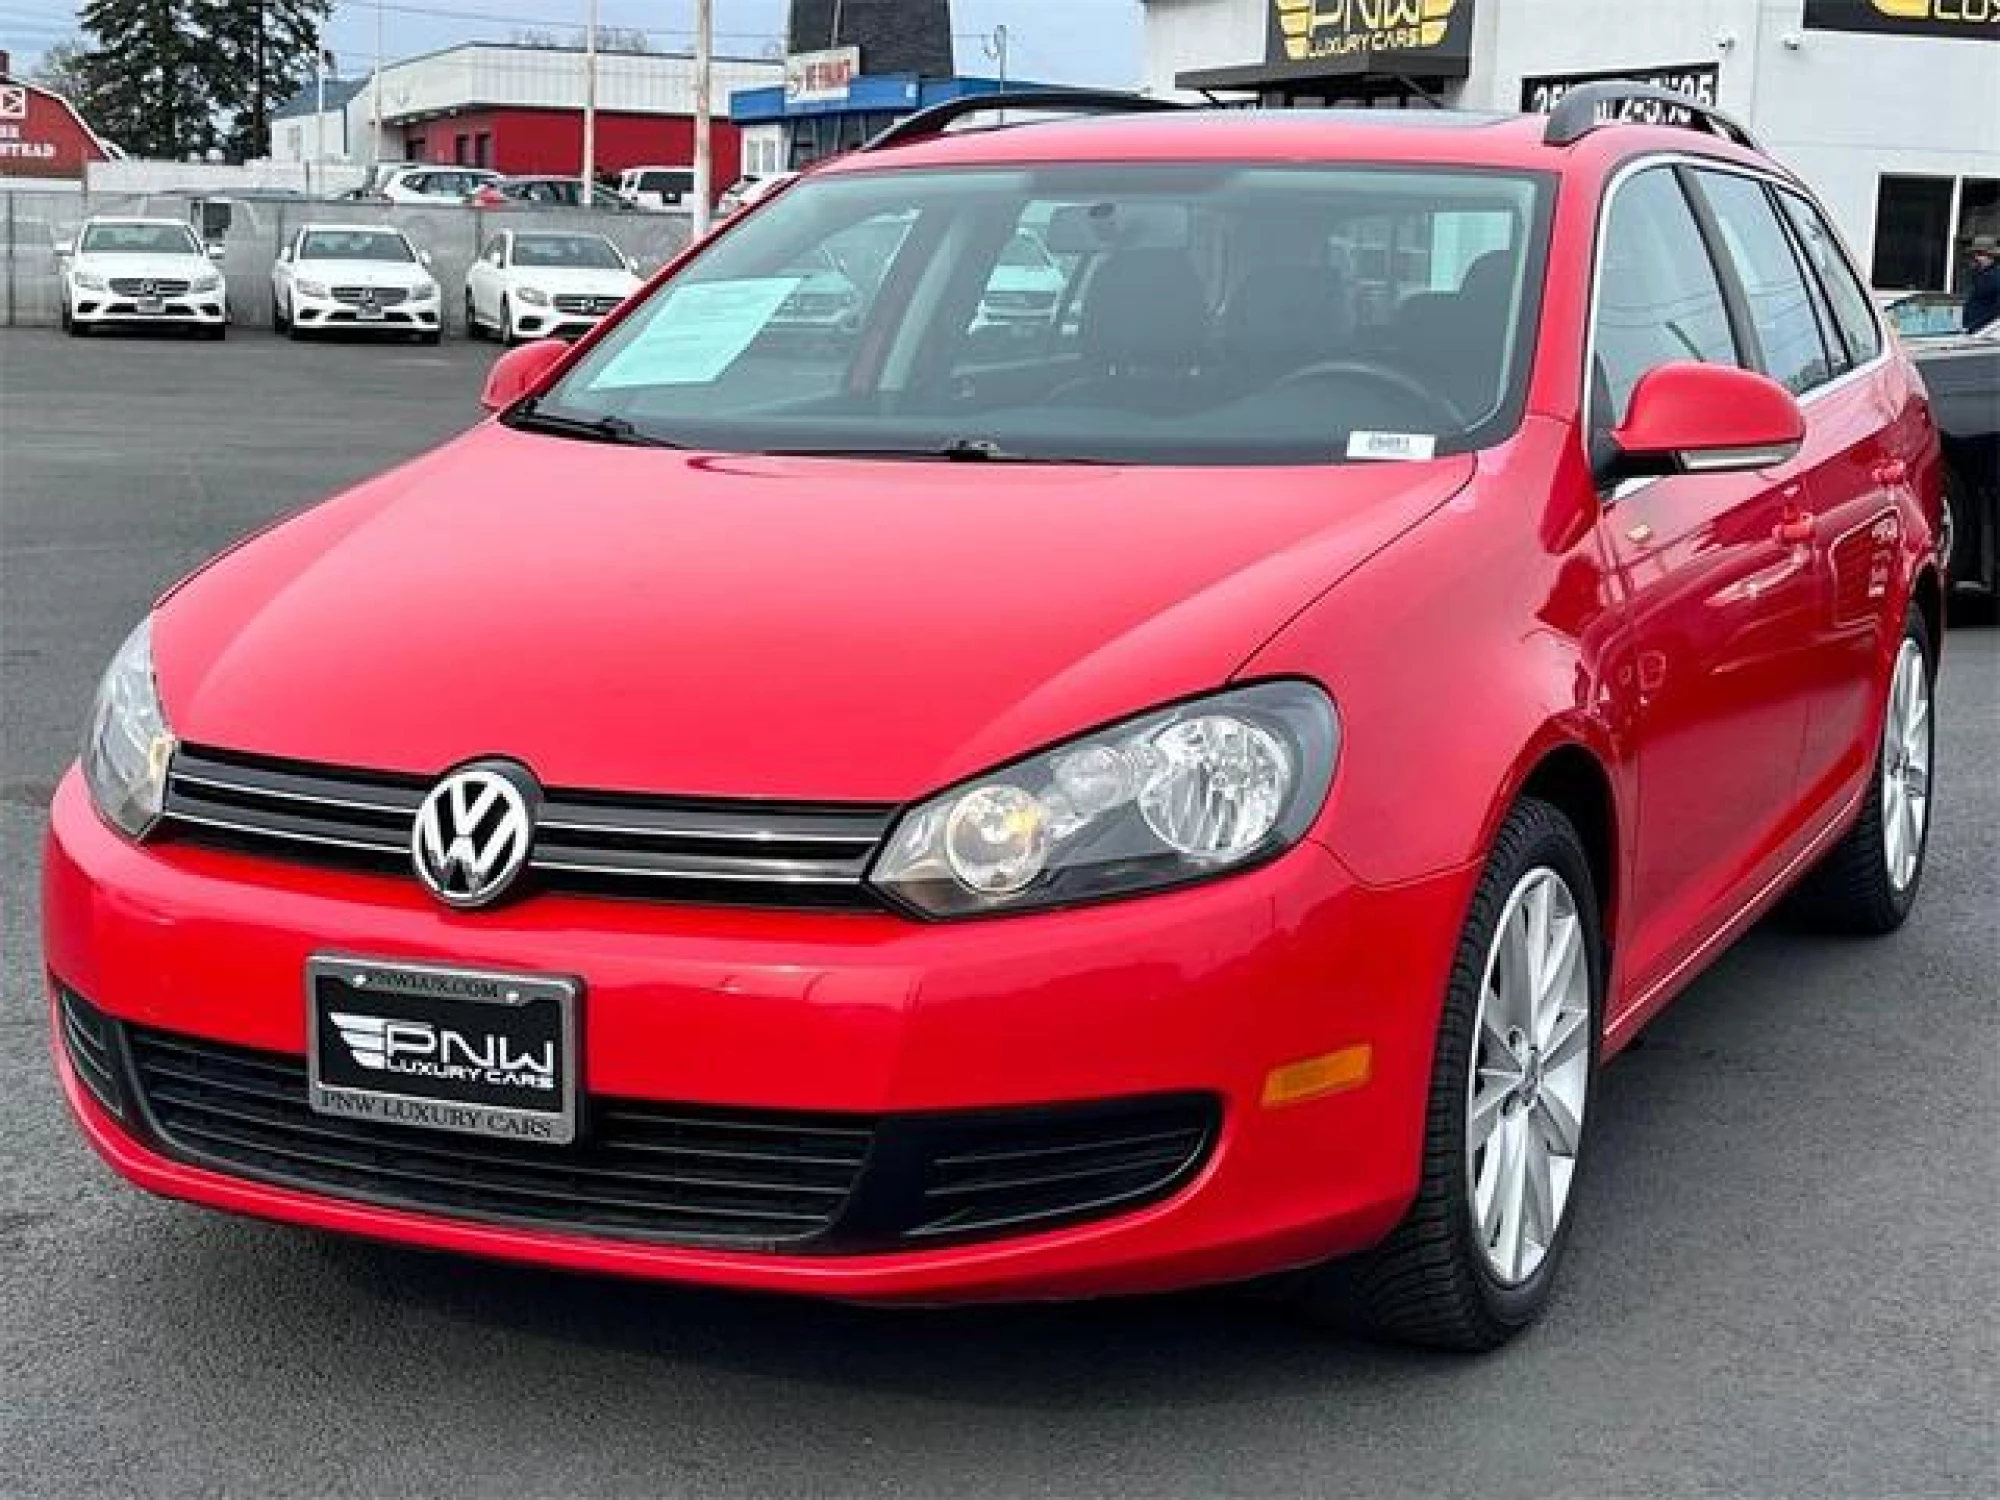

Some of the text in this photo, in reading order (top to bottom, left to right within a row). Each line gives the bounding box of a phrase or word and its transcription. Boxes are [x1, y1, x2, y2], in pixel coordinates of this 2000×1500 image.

[1309, 0, 1420, 38] PNW
[1309, 27, 1421, 57] LUXURY CARS
[387, 1023, 554, 1073] PNW
[387, 1058, 554, 1090] LUXURY CARS
[321, 1090, 552, 1138] PNW LUXURY CARS
